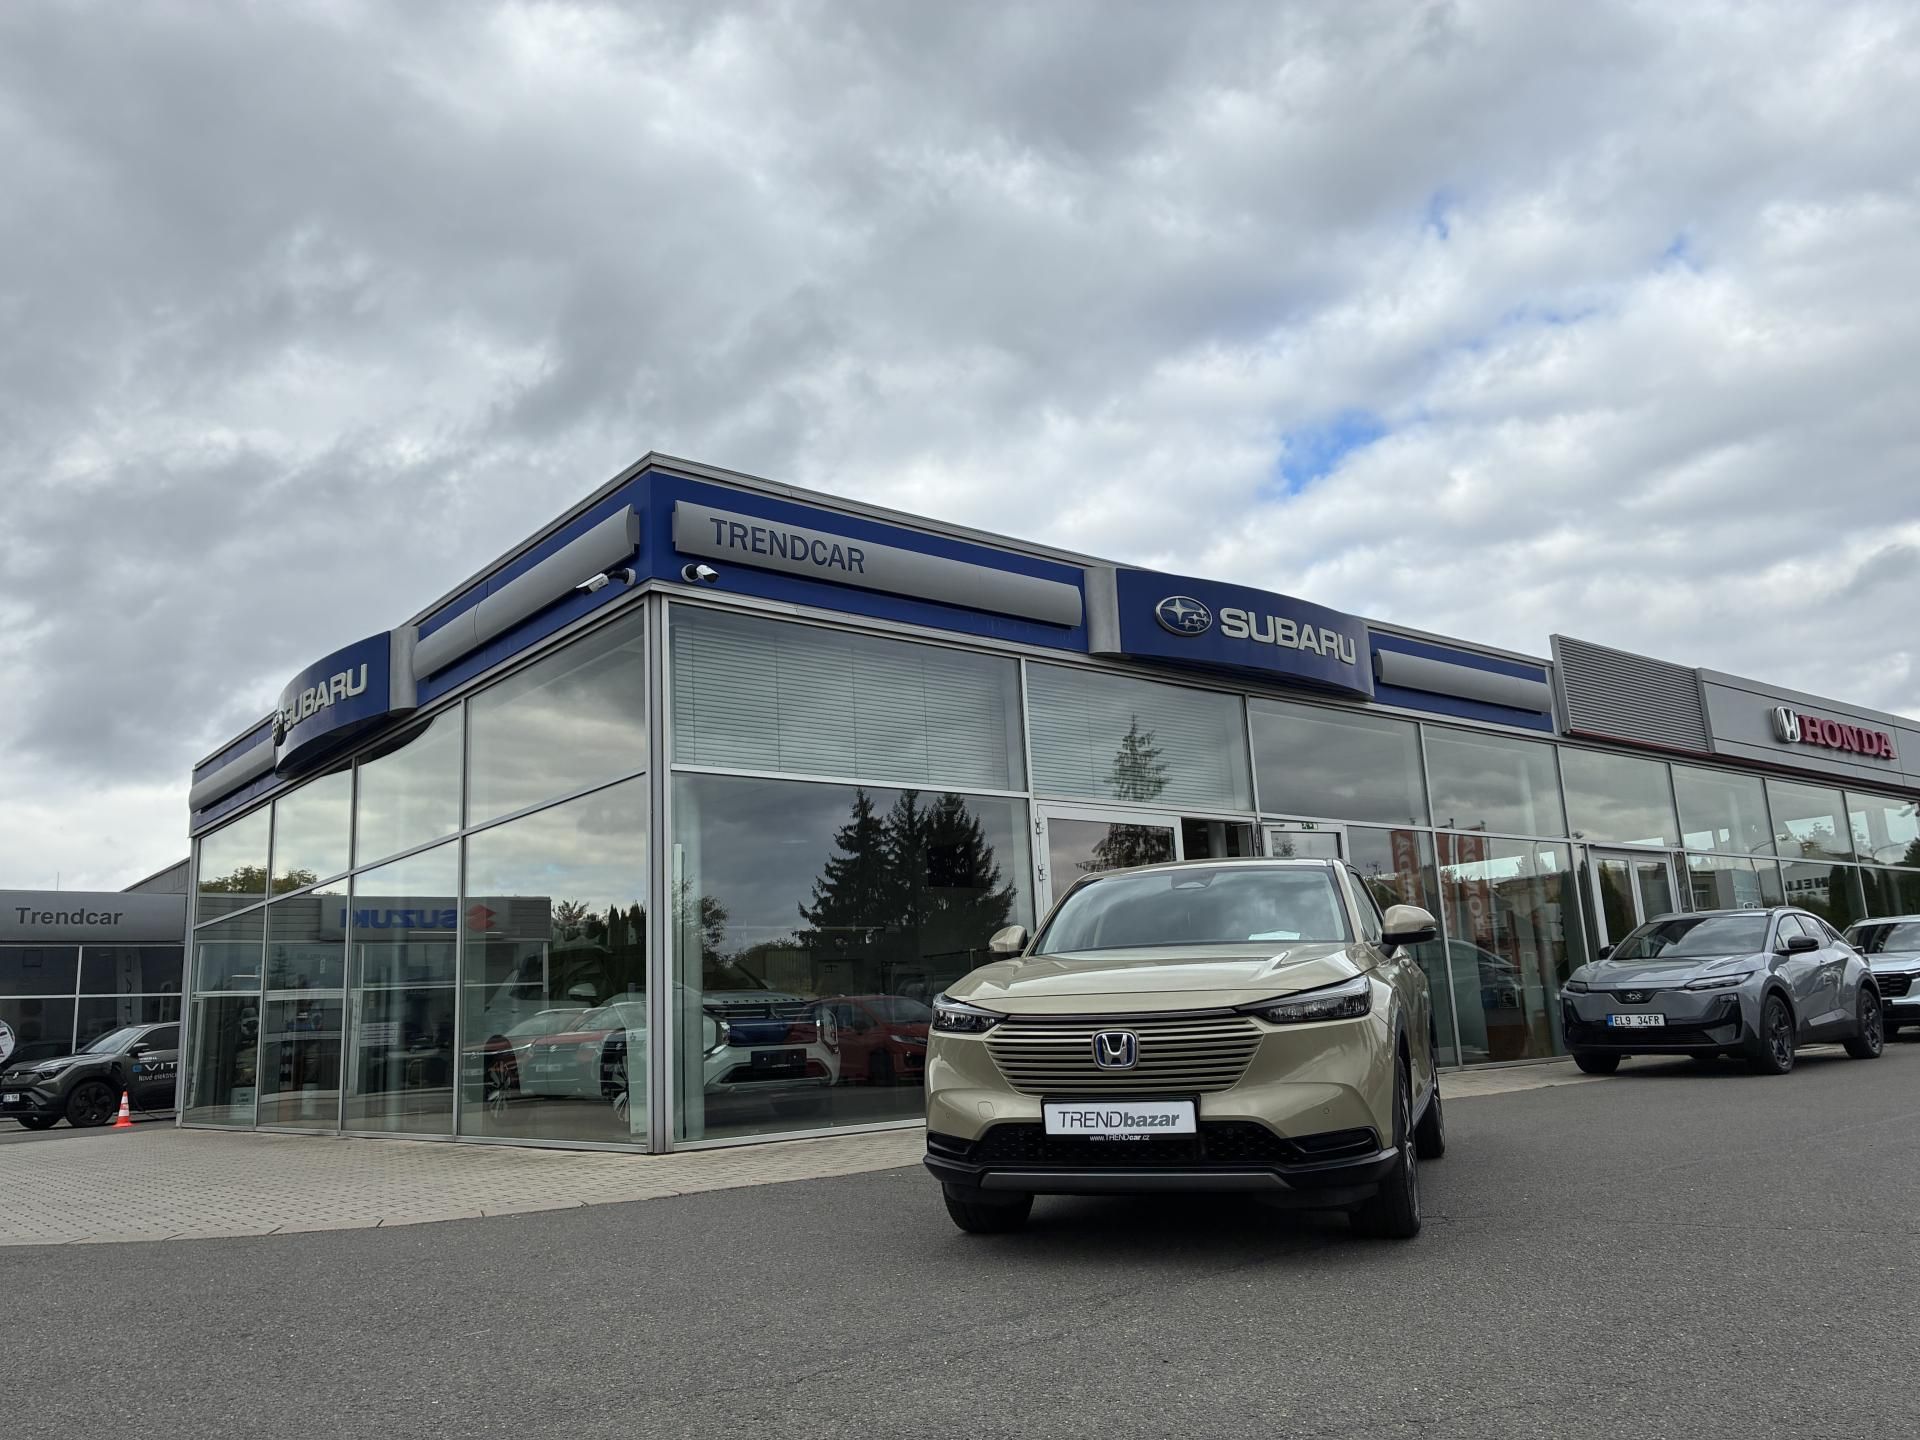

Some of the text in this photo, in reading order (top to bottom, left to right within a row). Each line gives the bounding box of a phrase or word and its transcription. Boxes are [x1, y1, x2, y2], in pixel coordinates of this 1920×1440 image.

[709, 517, 865, 574] TRENDCAR
[1219, 607, 1357, 665] SUBARU
[283, 663, 368, 732] SUBARU
[1797, 714, 1897, 760] HONDA
[15, 907, 124, 926] Trendcar
[1614, 1015, 1660, 1025] EL9 34FR
[1058, 1111, 1179, 1128] TRENDbazar
